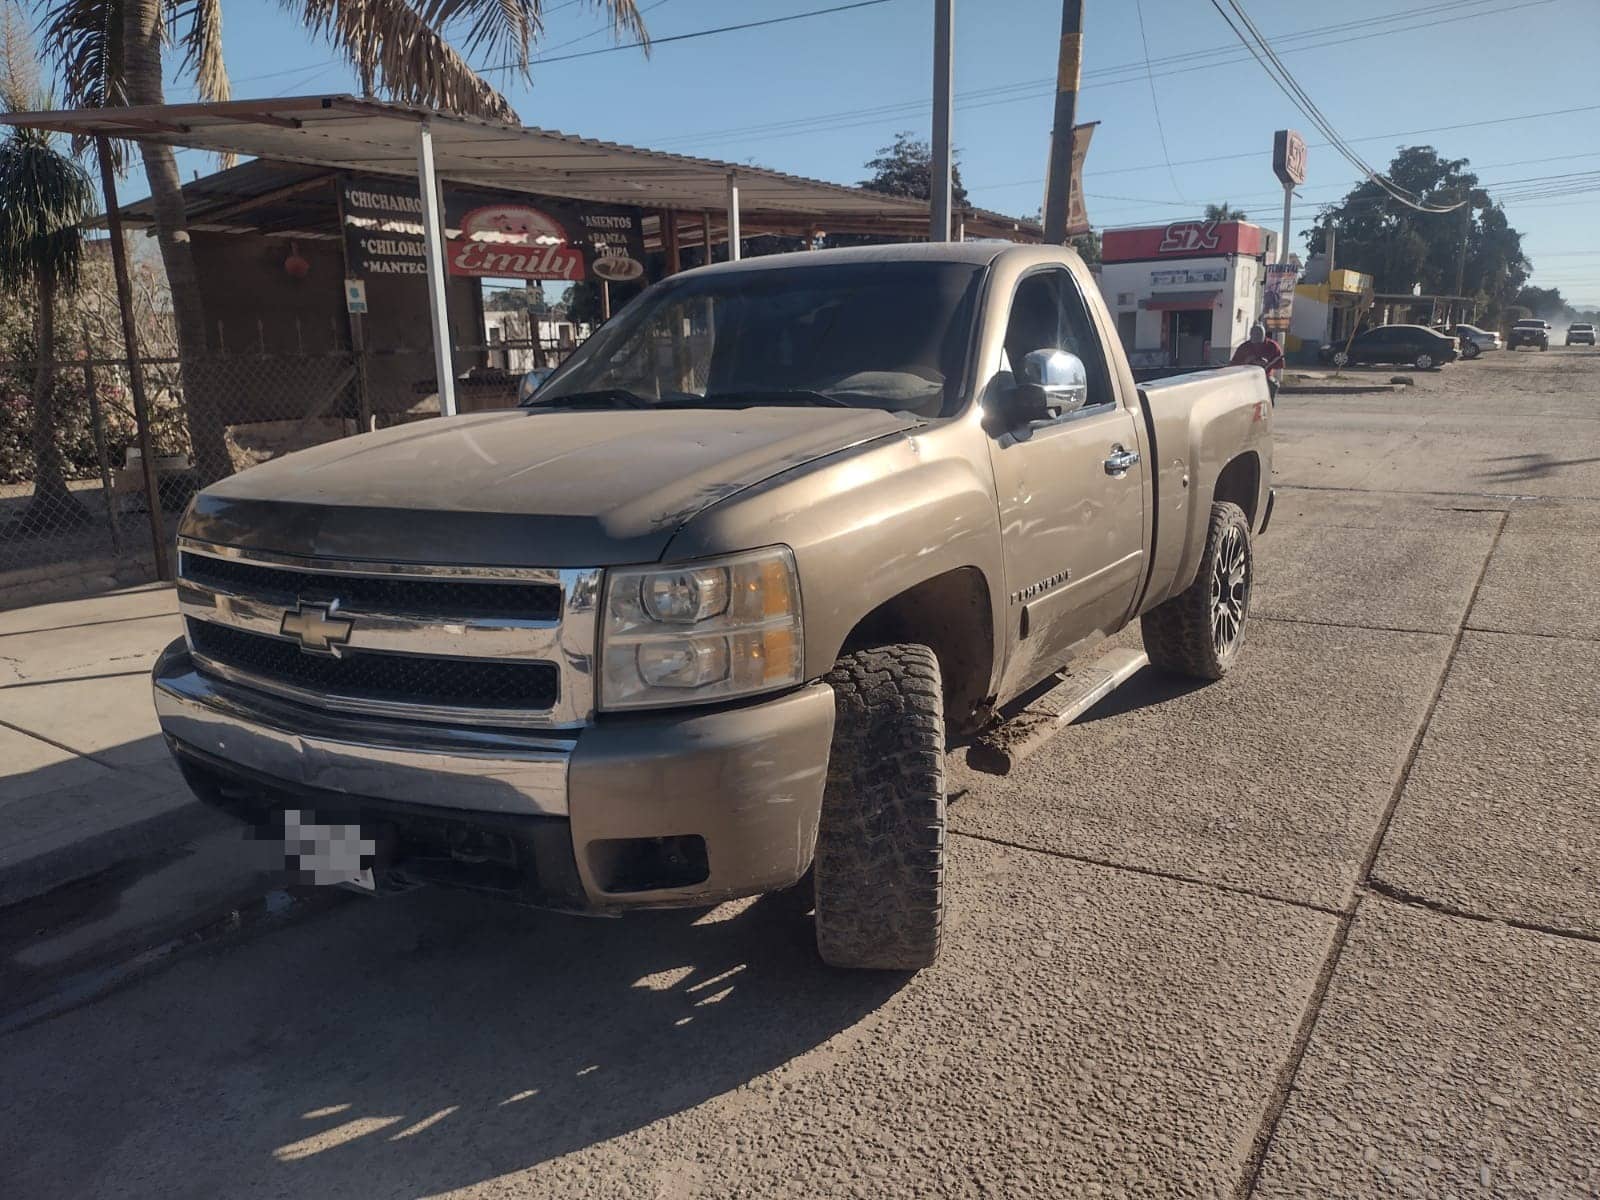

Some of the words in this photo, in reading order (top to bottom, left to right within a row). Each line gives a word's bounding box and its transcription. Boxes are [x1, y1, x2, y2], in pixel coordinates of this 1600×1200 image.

[1160, 219, 1219, 251] SIX
[369, 261, 427, 274] MANTEC
[455, 243, 576, 279] Emily
